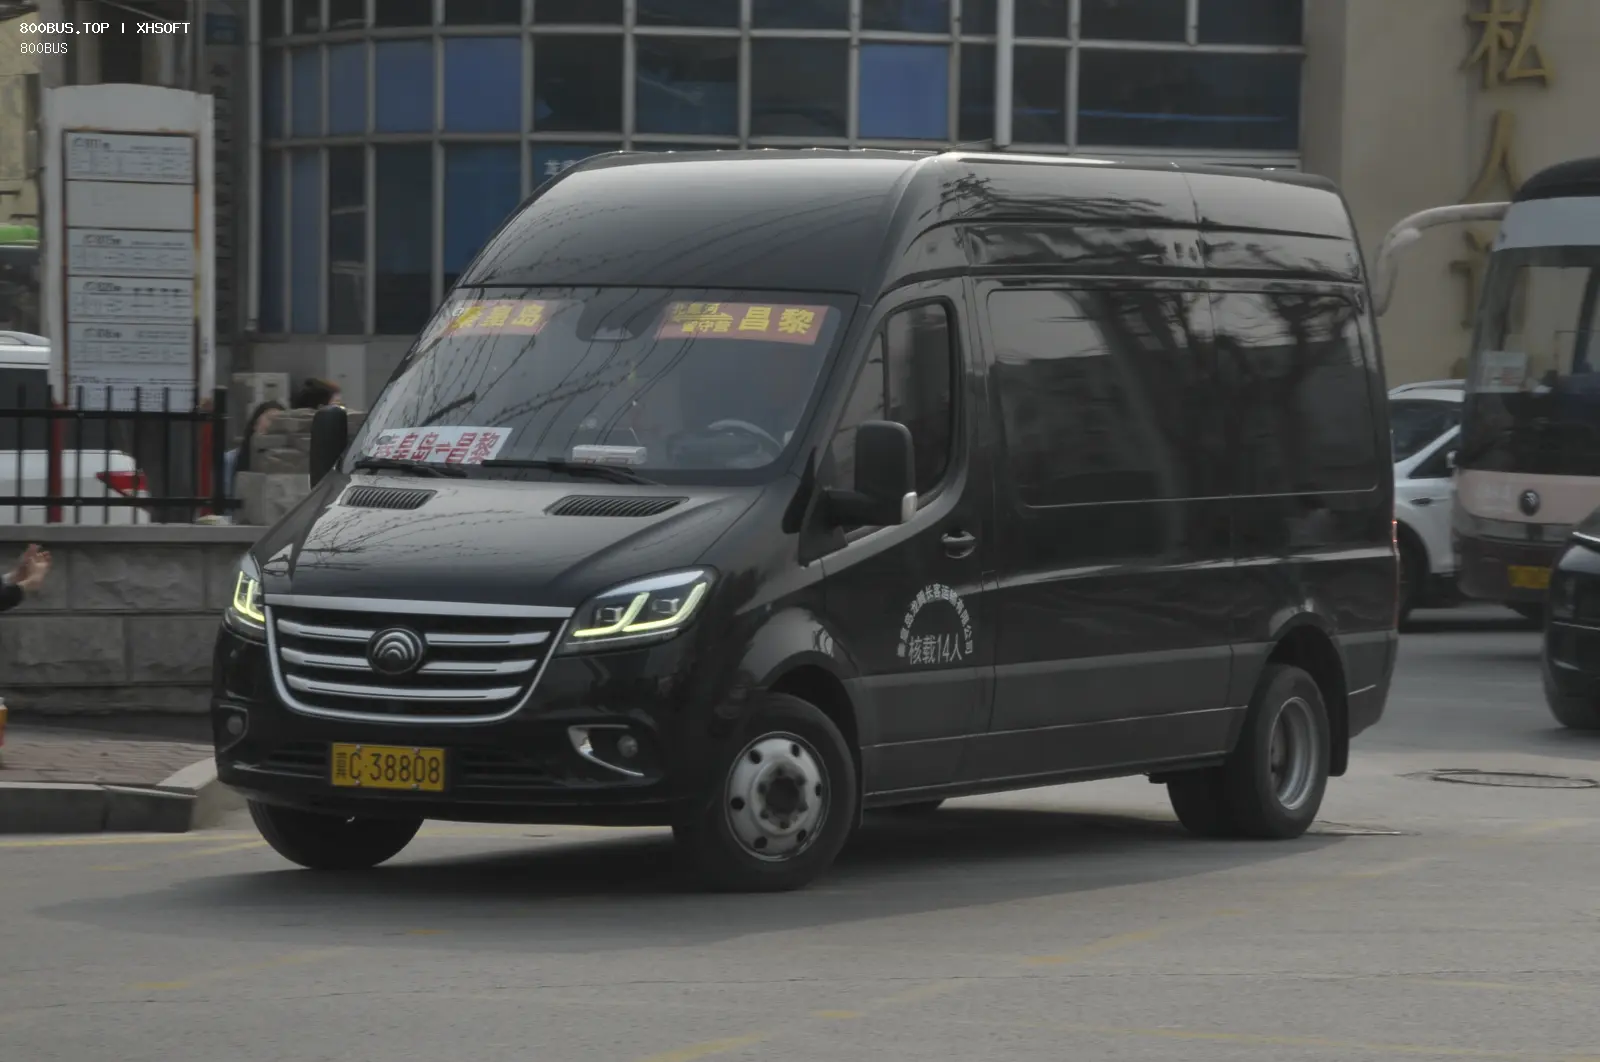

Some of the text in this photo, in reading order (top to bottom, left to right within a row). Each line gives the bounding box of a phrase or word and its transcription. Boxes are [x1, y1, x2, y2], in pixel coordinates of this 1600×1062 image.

[738, 306, 816, 335] 昌黎
[897, 583, 974, 658] 岛龙长客运输有限公司
[909, 633, 963, 665] 核载14人
